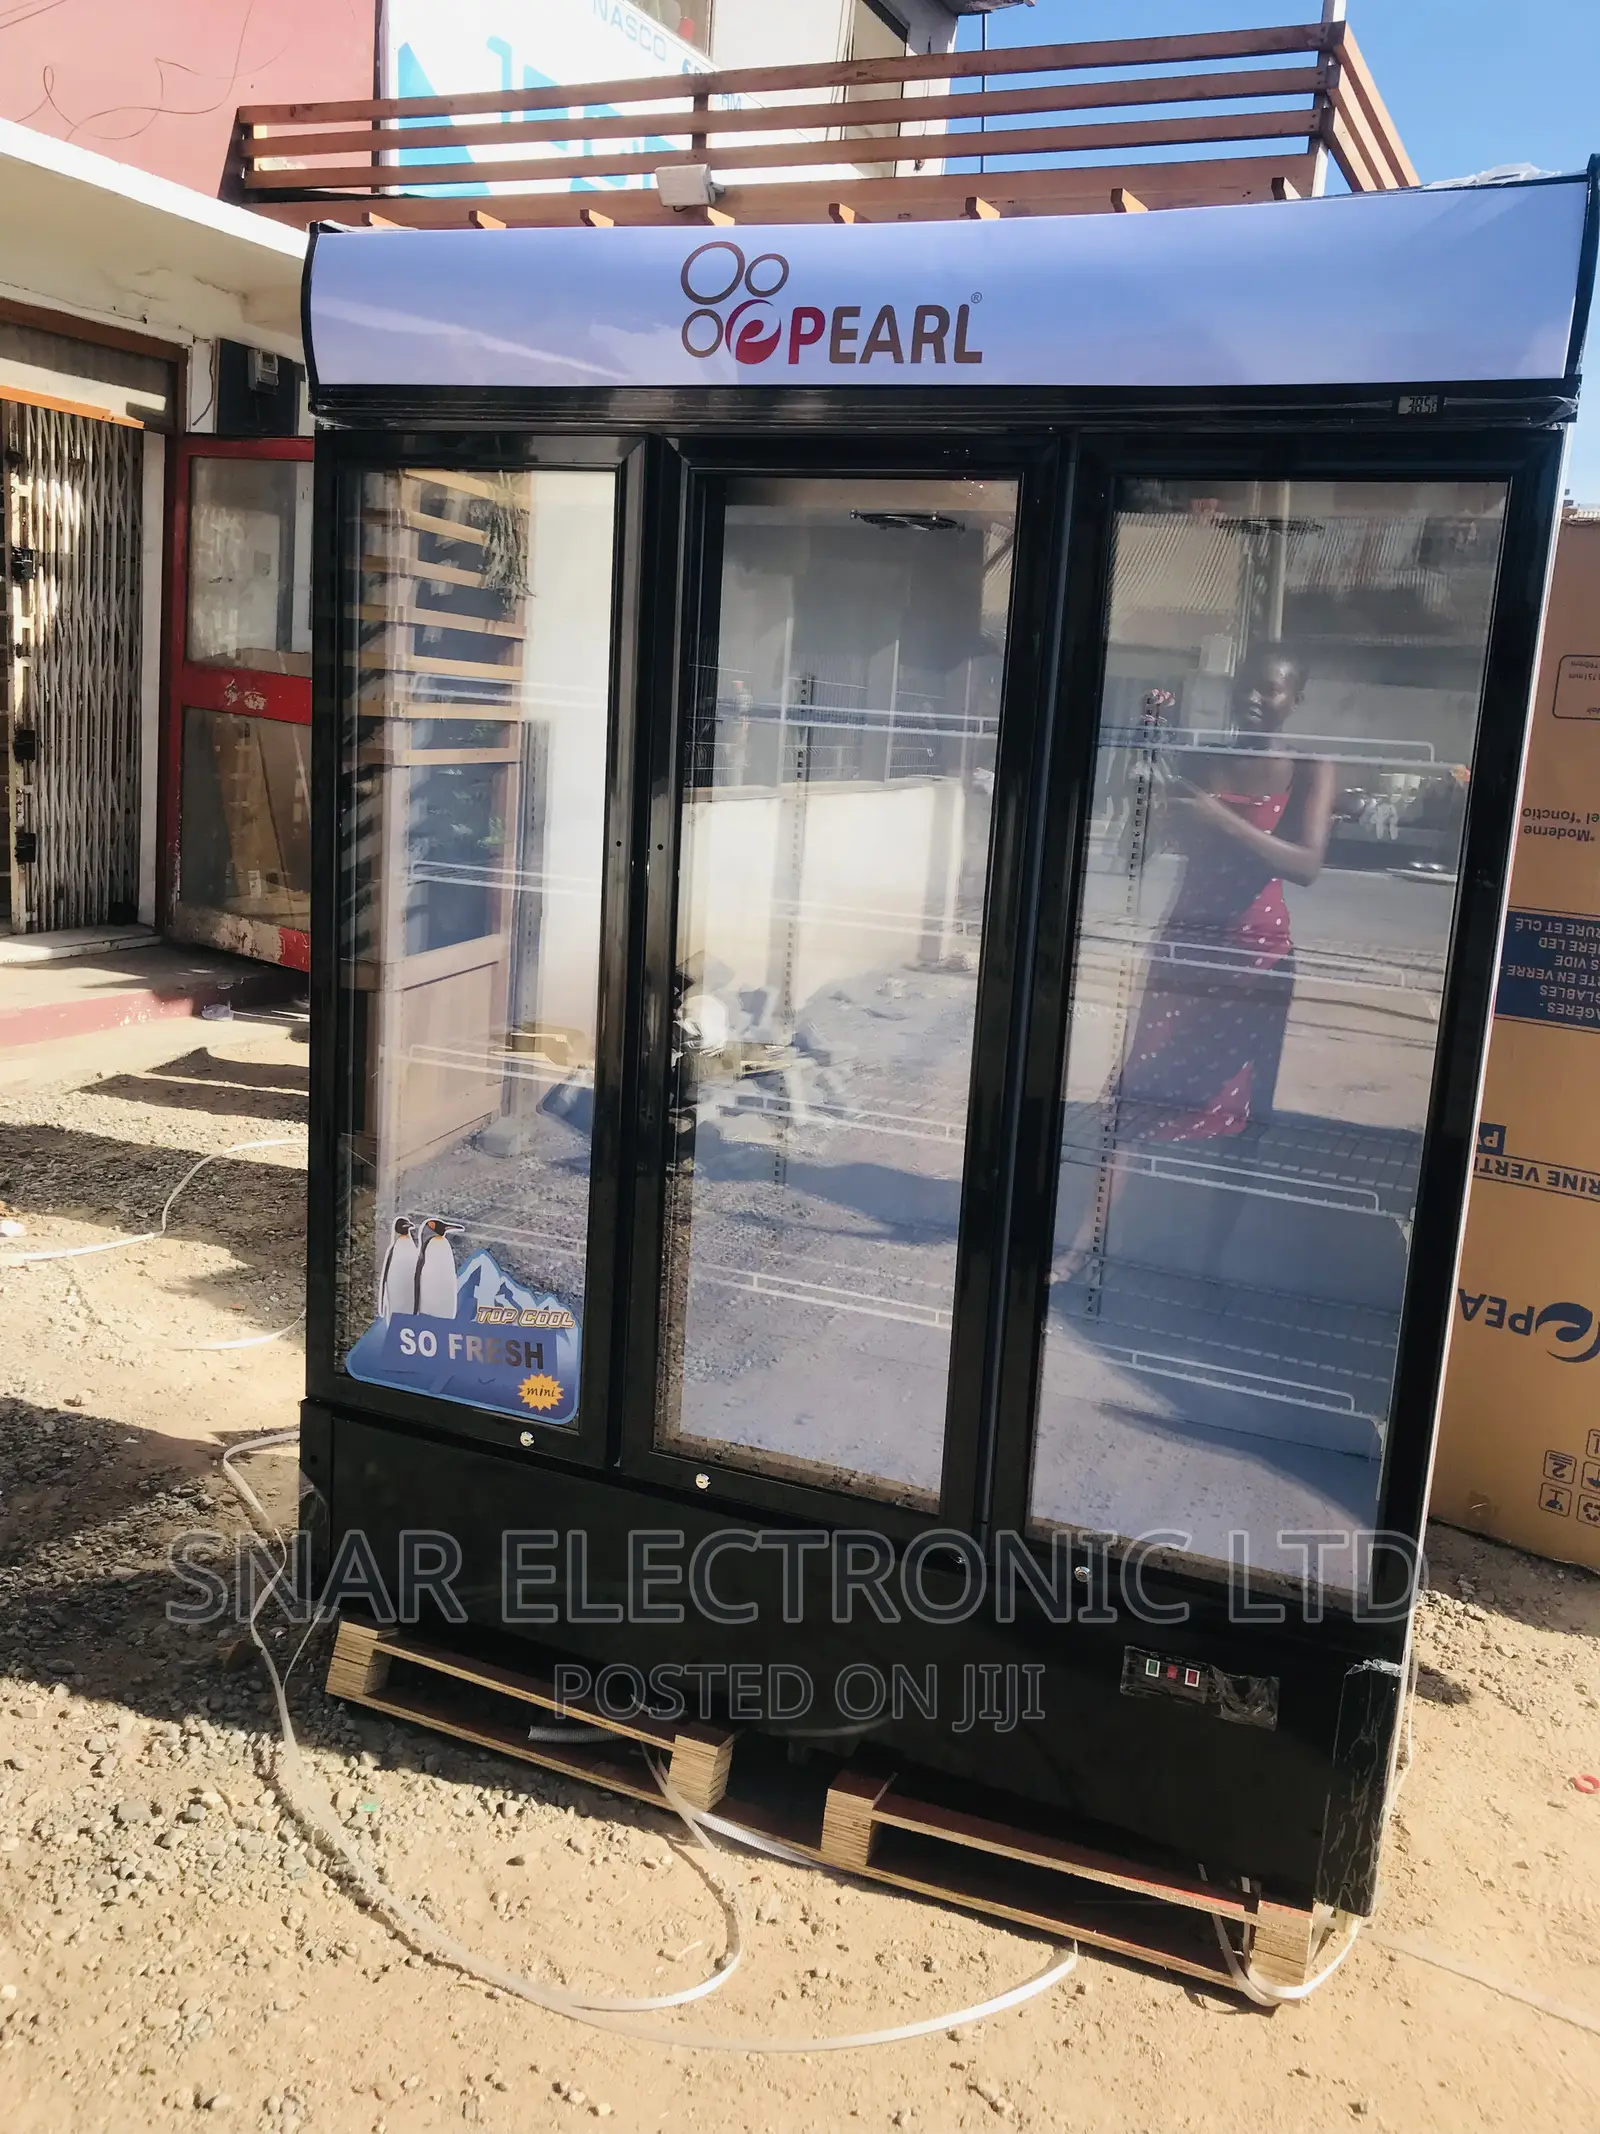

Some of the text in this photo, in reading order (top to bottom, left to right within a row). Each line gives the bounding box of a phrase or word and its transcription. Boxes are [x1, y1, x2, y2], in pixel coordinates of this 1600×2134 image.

[592, 0, 666, 62] NASCO
[788, 304, 983, 365] PEARL
[1514, 918, 1542, 931] CLÉ
[1545, 921, 1563, 934] ET
[1538, 937, 1566, 950] LED
[1554, 955, 1587, 968] VIDE
[1506, 964, 1554, 981] VERRE
[1557, 971, 1576, 983] EN
[476, 1306, 576, 1329] TOP COOL
[400, 1327, 545, 1371] SO FRESH
[526, 1384, 556, 1398] mini
